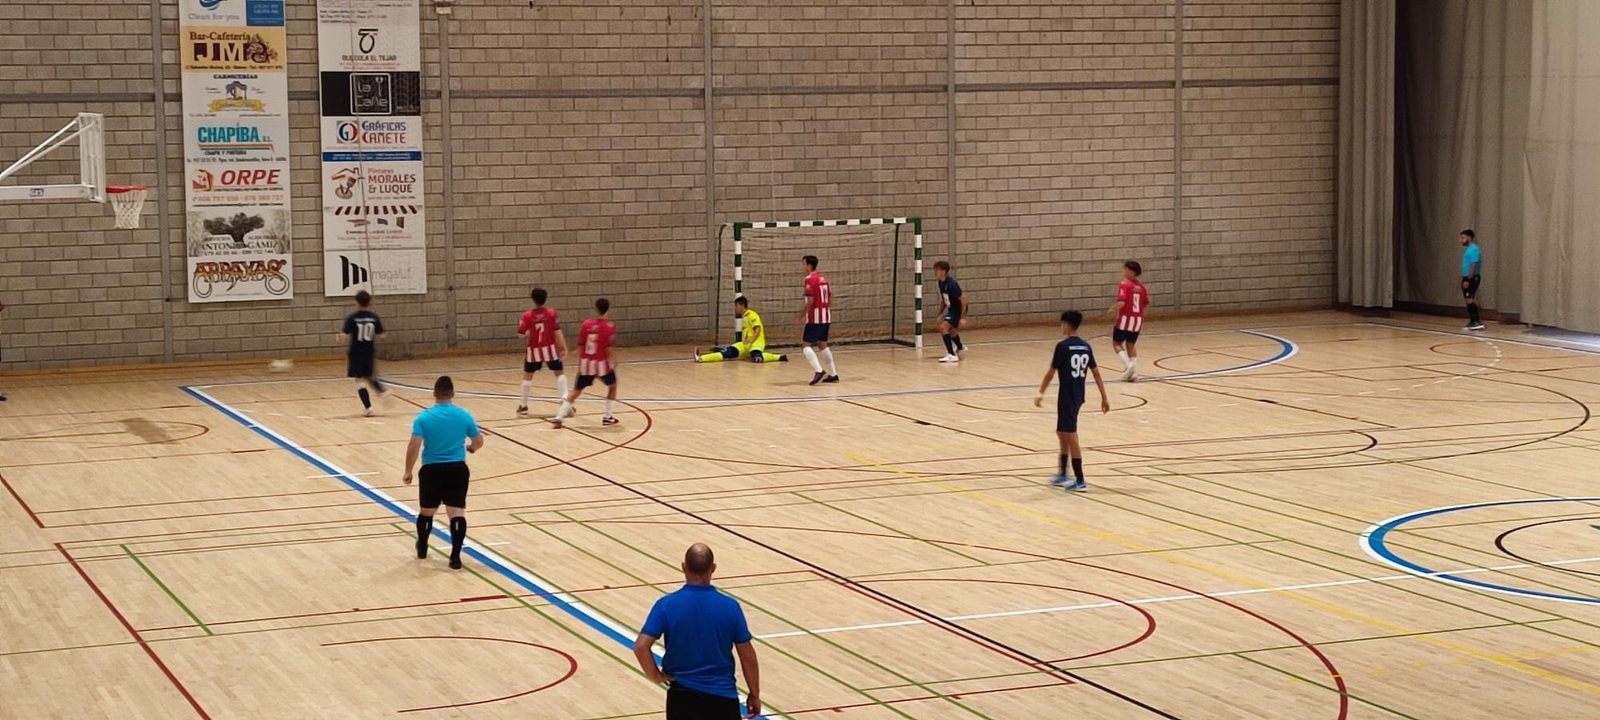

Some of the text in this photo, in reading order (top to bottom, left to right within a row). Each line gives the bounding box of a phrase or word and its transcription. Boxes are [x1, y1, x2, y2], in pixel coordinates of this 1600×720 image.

[221, 169, 281, 185] ORPE
[368, 174, 416, 184] MORALES
[368, 184, 412, 195] & LUQUE
[1133, 293, 1140, 312] 9
[357, 322, 376, 342] 10
[535, 323, 545, 342] 7
[1070, 353, 1090, 378] 99
